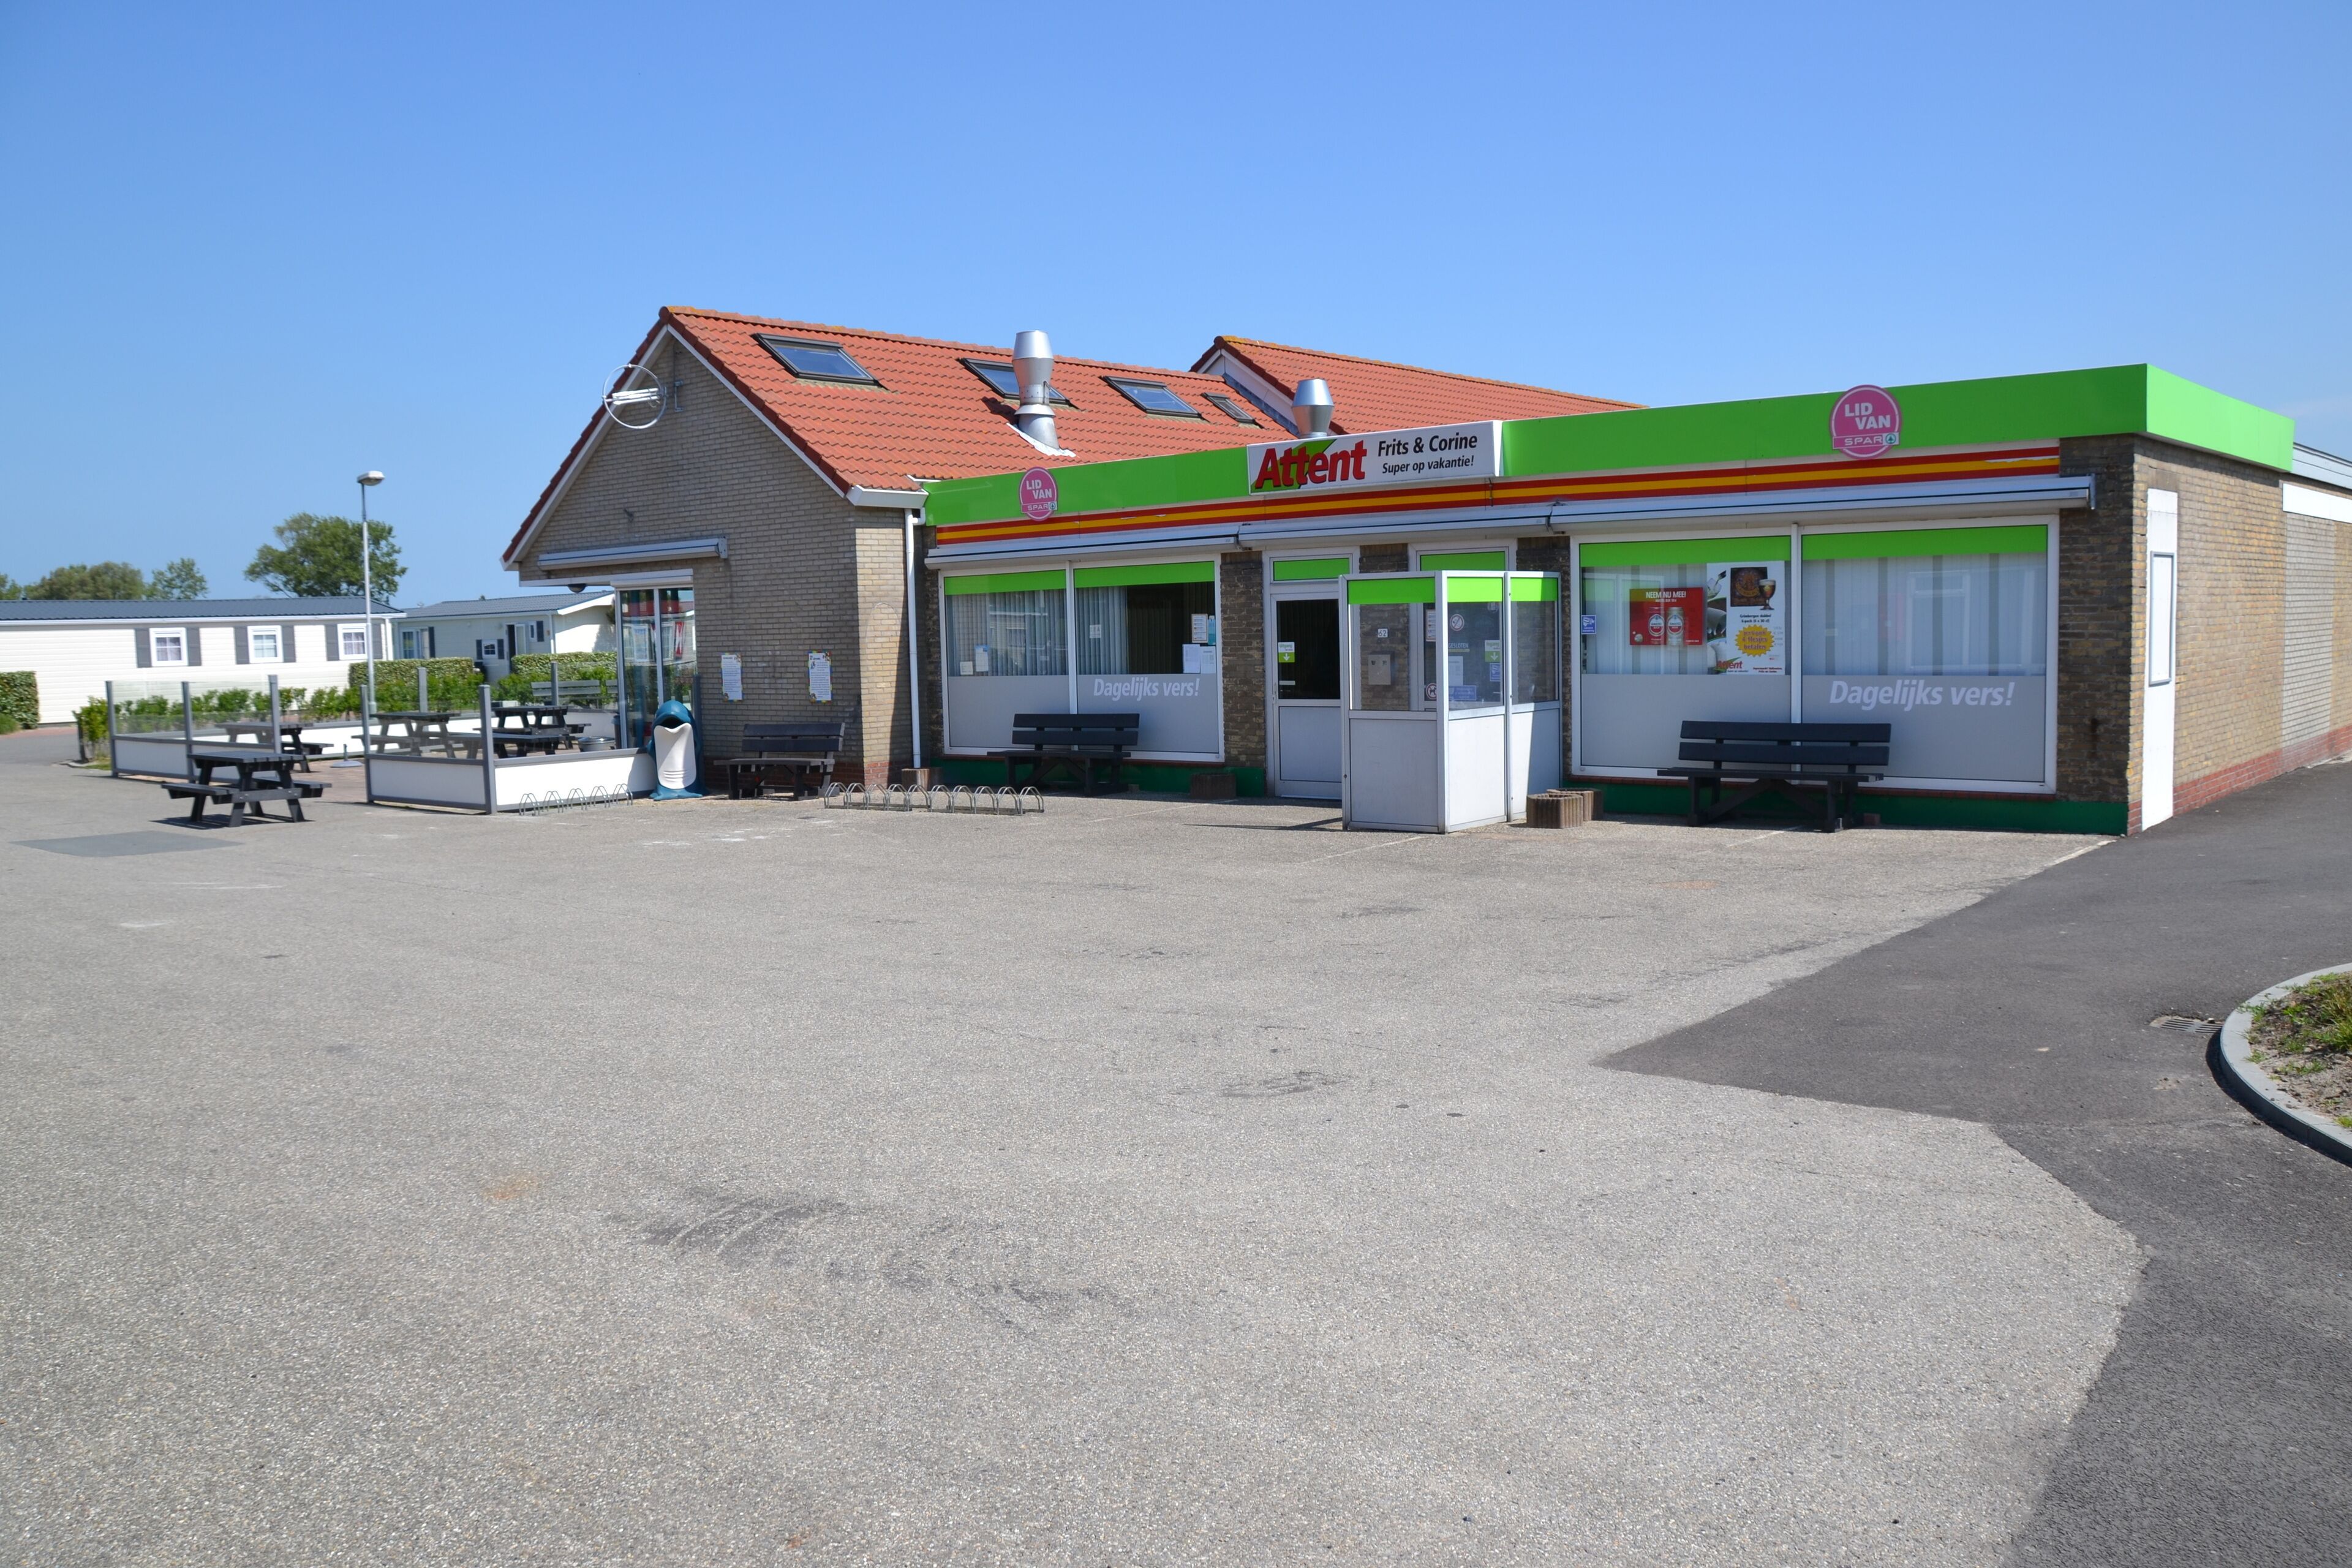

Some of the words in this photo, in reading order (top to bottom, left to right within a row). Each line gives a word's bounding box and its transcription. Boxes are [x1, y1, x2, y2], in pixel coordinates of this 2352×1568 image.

[1845, 402, 1873, 417] LID
[1855, 415, 1891, 430] VAN
[1378, 439, 1409, 457] Frits
[1413, 437, 1425, 453] &
[1429, 432, 1478, 452] Corine
[1844, 436, 1882, 446] SPAR
[1254, 440, 1367, 489] Attent
[1382, 462, 1410, 476] Super
[1412, 462, 1425, 473] op
[1427, 455, 1474, 470] vakantie!
[1026, 480, 1042, 490] LID
[1032, 489, 1052, 499] VAN
[1093, 677, 1159, 701] Dagelijks
[1163, 678, 1200, 696] vers!
[1829, 679, 1943, 712] Dagelijks
[1950, 682, 2015, 706] vers!
